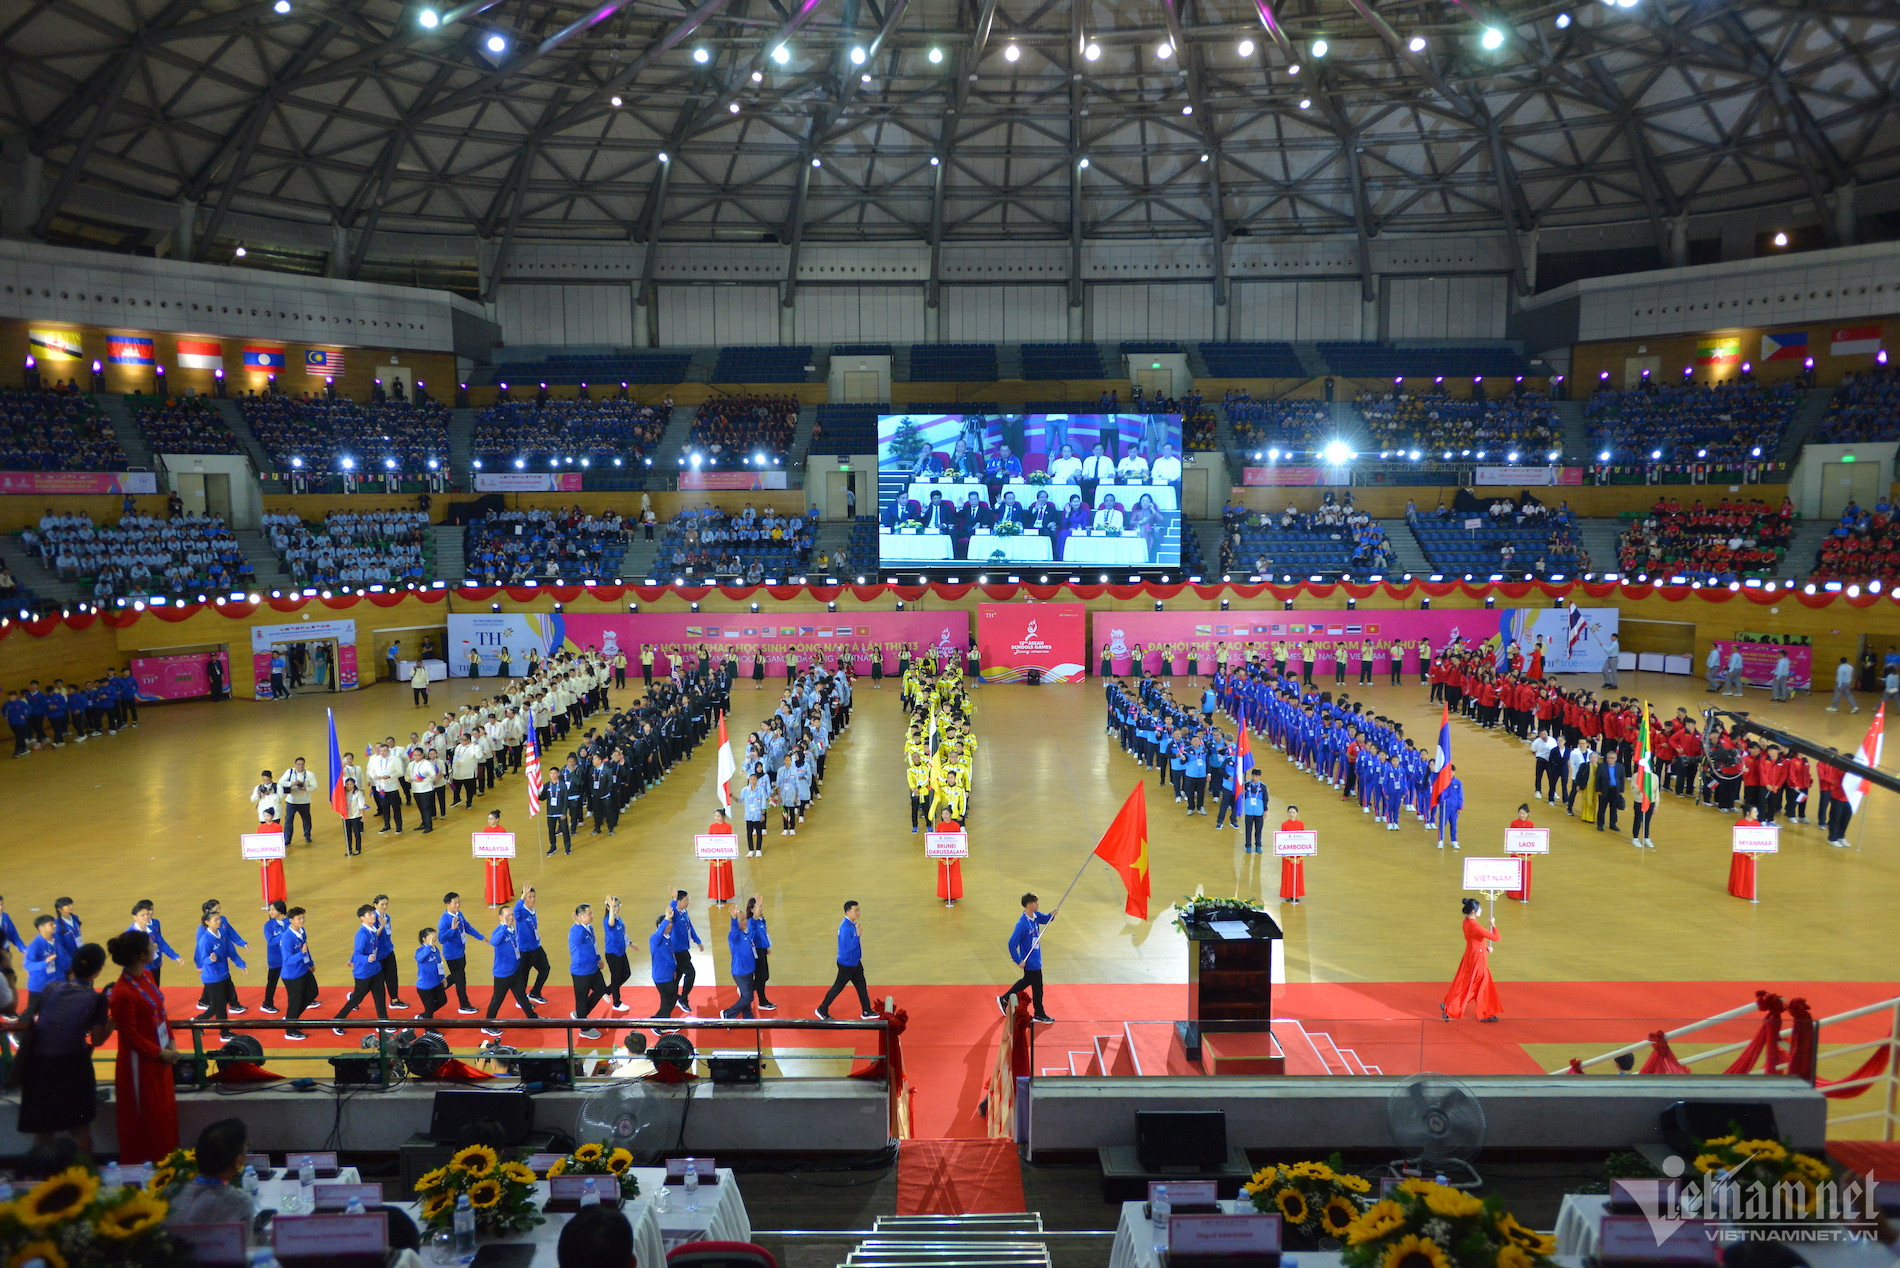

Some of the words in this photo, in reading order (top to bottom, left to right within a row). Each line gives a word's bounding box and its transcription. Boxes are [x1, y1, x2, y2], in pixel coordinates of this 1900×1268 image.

[475, 632, 502, 645] TH
[762, 643, 787, 652] SINH
[909, 642, 919, 650] 13
[1212, 641, 1242, 651] TAO
[1233, 653, 1272, 661] SCOLS
[1278, 843, 1313, 851] CAMBODIA
